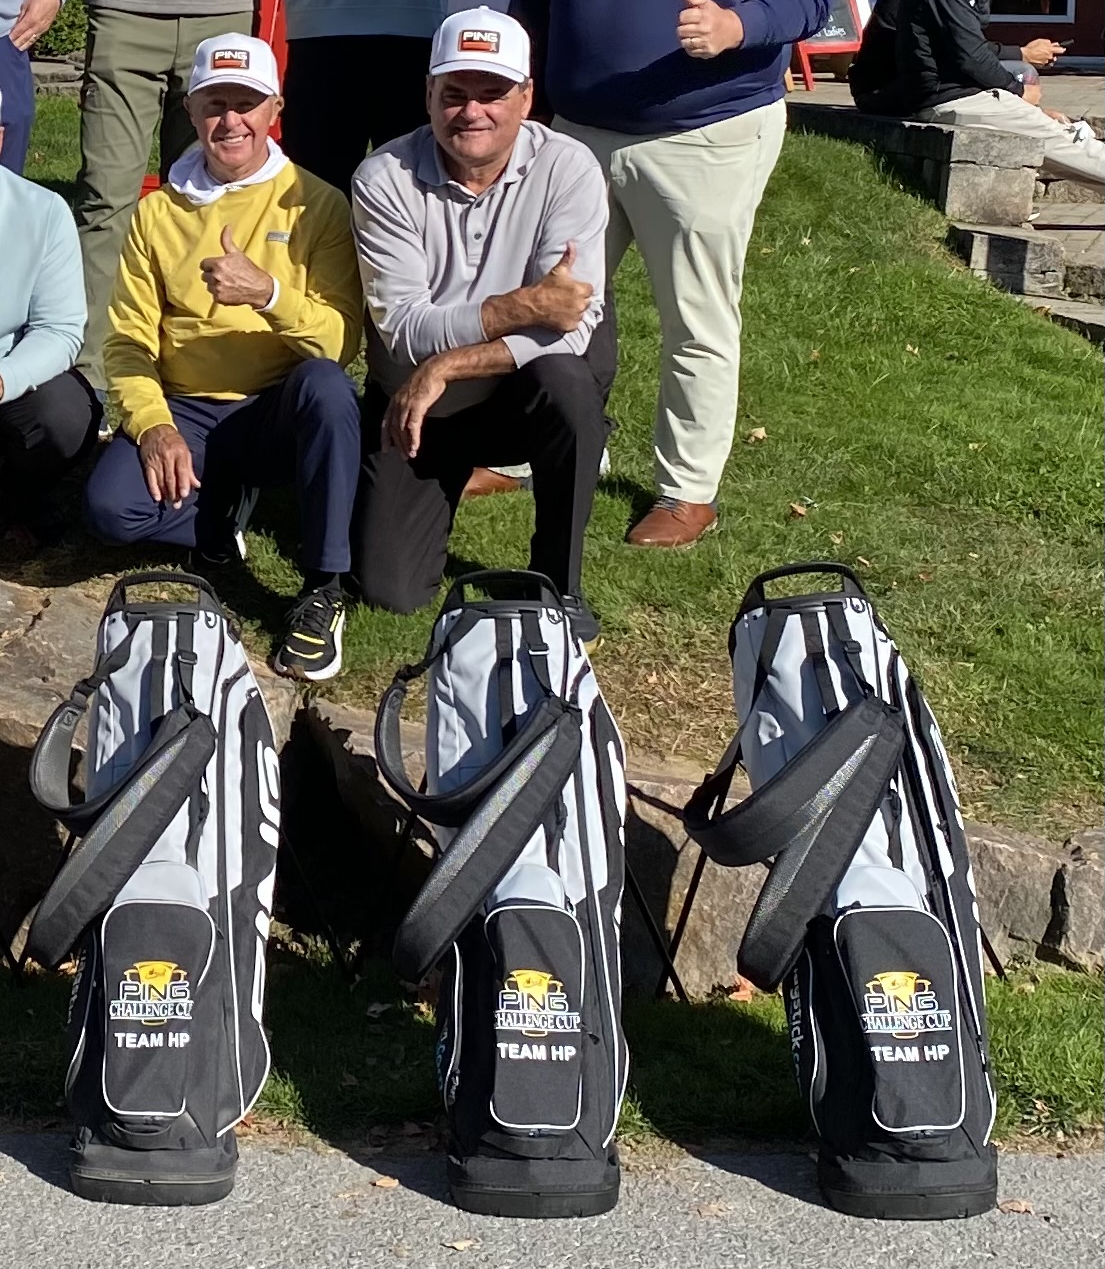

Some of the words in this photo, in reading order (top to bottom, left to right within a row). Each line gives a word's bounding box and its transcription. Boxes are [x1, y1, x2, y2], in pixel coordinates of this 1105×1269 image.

[463, 31, 498, 42] PING
[214, 50, 248, 60] PING
[119, 980, 190, 1001] PING
[109, 1002, 174, 1017] CHALLENGE
[176, 1002, 194, 1017] CU
[499, 989, 569, 1012] PING
[863, 990, 939, 1014] PING
[495, 1012, 555, 1029] HALLENGE
[555, 1015, 581, 1030] CUP
[925, 1013, 952, 1029] CUP
[114, 1032, 164, 1048] TEAM
[168, 1031, 190, 1048] HP
[496, 1042, 547, 1061] TEAM
[550, 1045, 577, 1062] HP
[870, 1046, 920, 1062] TEAM
[923, 1043, 950, 1061] HP
